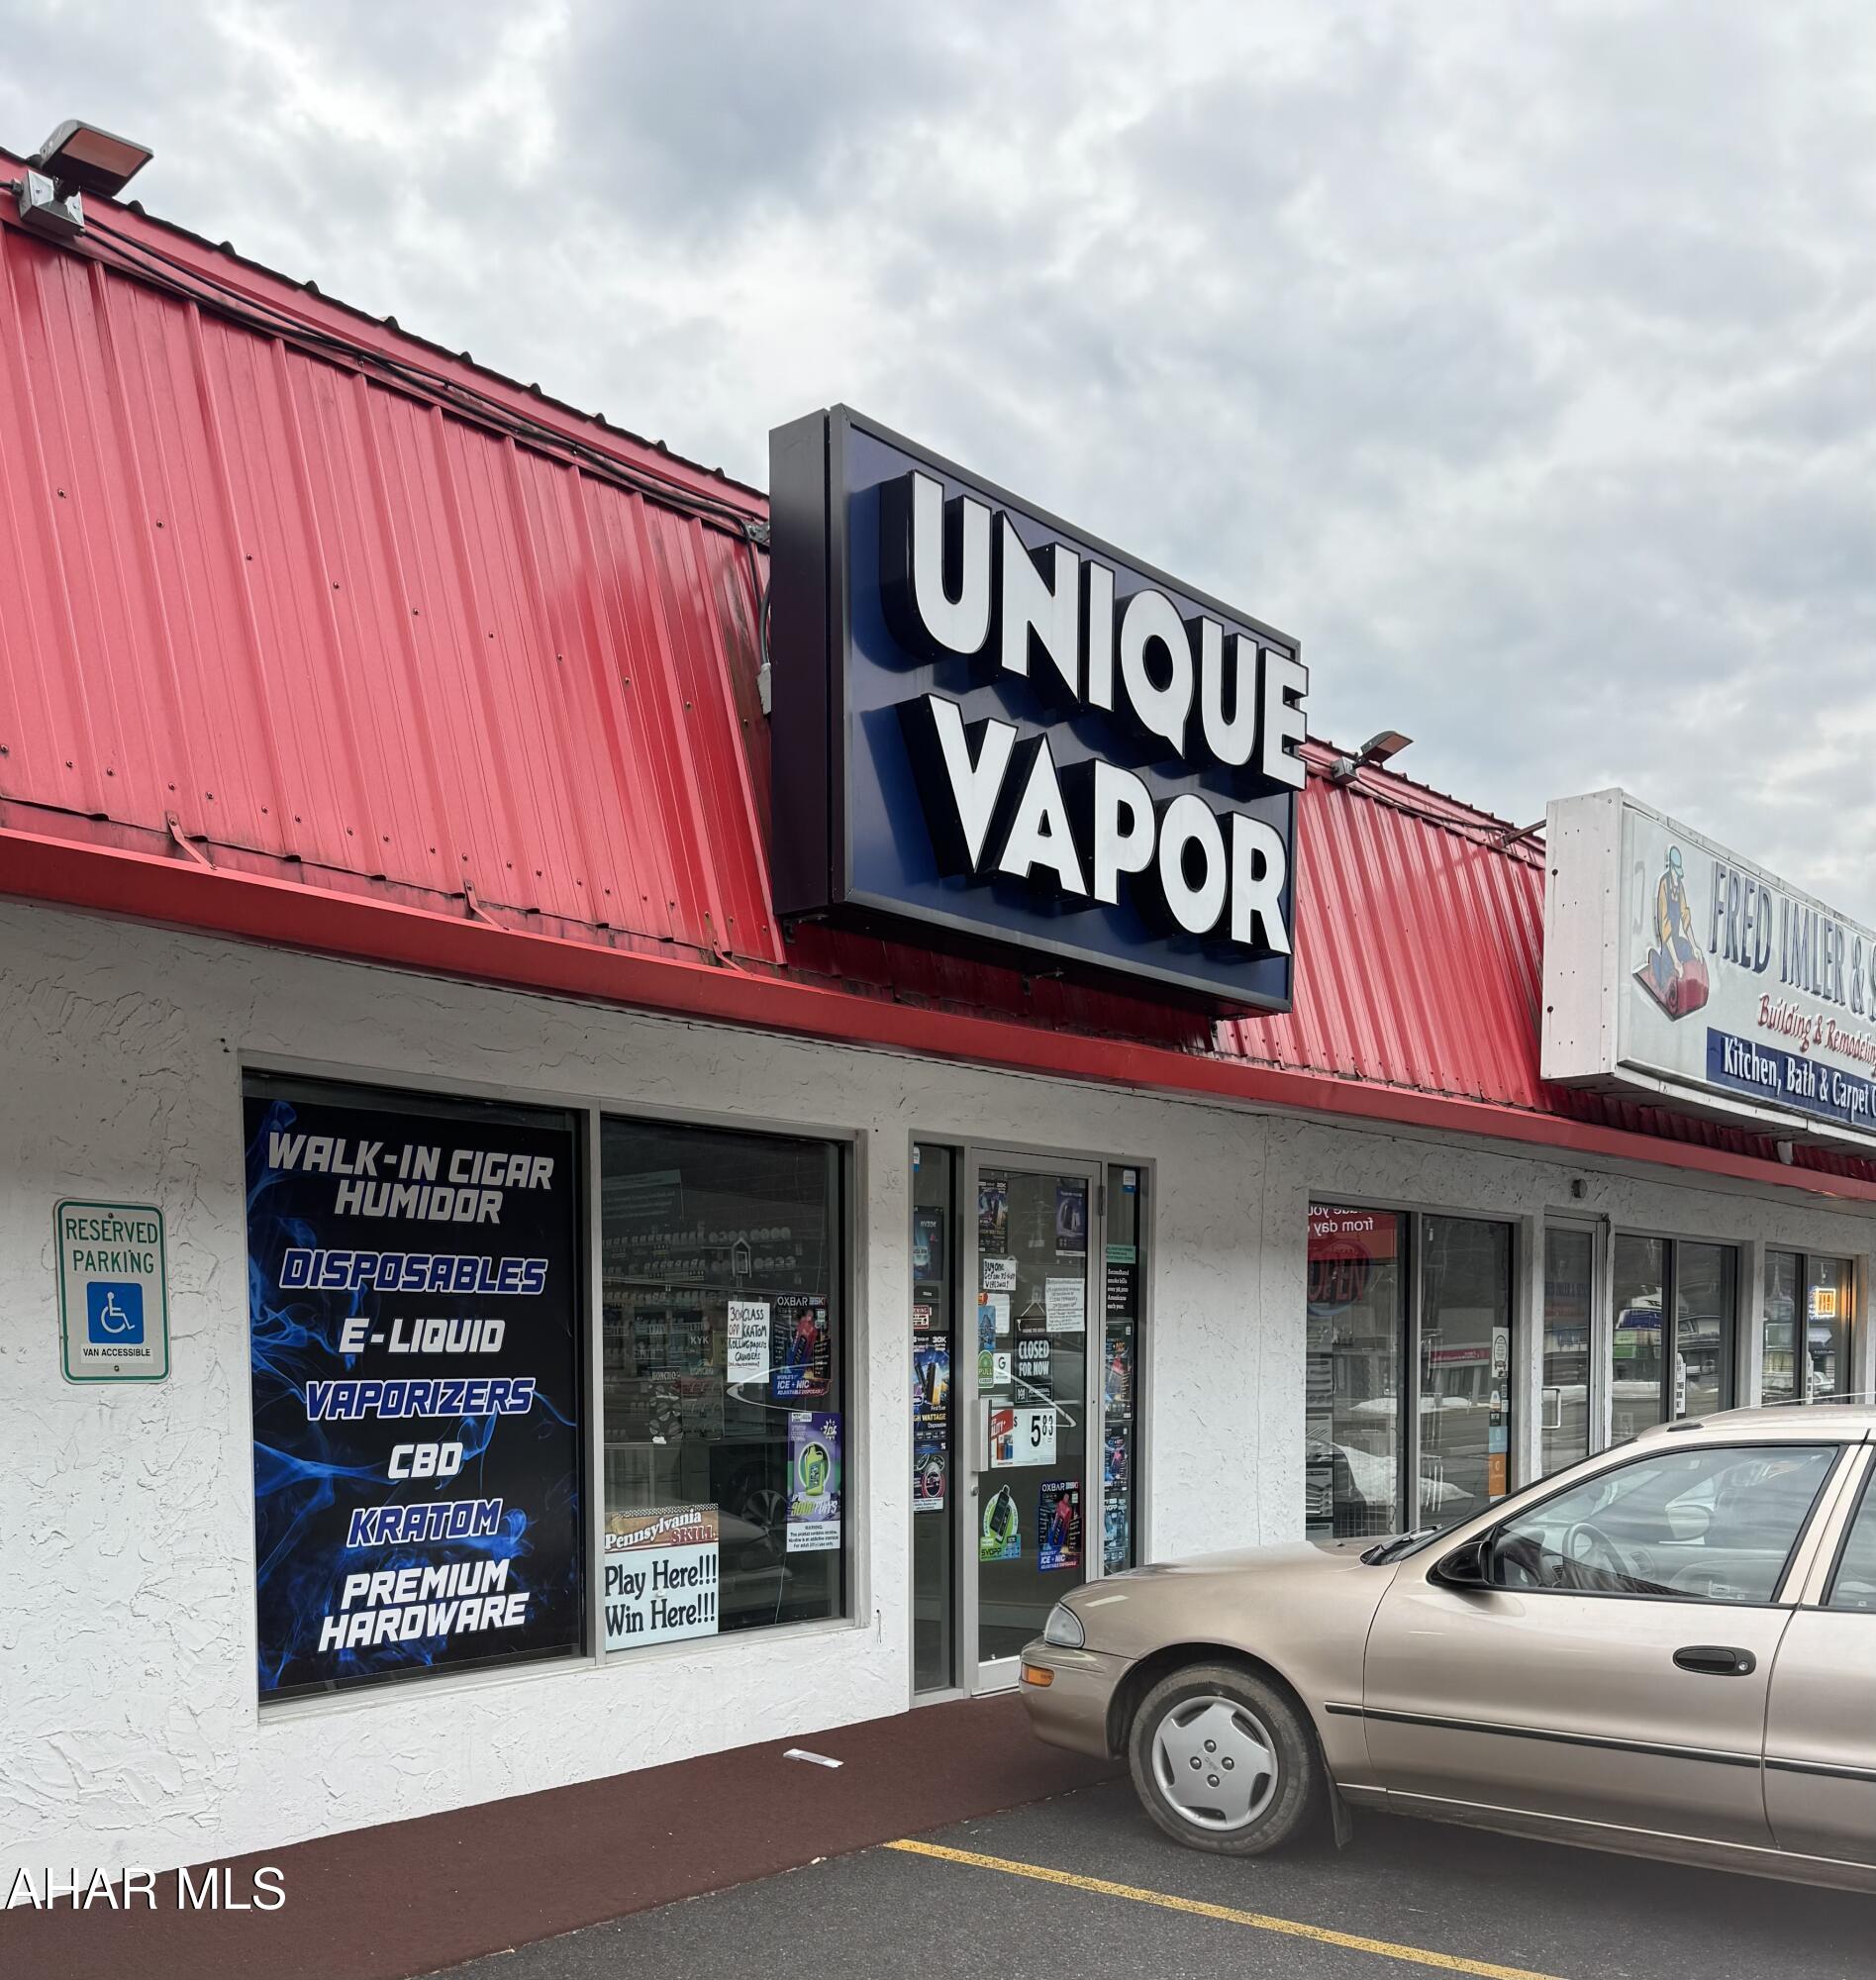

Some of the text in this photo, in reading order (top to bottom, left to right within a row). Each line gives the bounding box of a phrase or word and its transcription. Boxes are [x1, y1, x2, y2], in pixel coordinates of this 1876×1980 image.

[910, 469, 1309, 792] UNIQUE
[928, 693, 1292, 955] VAPOR
[1709, 860, 1772, 973] FRED
[1780, 897, 1845, 1006] IMLER
[1851, 936, 1864, 1015] &
[1757, 993, 1876, 1077] Building & Remodelin
[1725, 1037, 1782, 1097] Kitchen,
[1787, 1056, 1815, 1098] Bath
[1819, 1068, 1828, 1102] &
[1831, 1071, 1869, 1123] Carpet
[268, 1132, 555, 1190] WALK-IN CIGAR
[334, 1180, 504, 1224] HUMIDOR
[65, 1219, 158, 1244] RESERVED
[73, 1249, 153, 1274] PARKING
[279, 1248, 548, 1295] DISPOSABLES
[777, 1297, 808, 1306] OXBAR
[101, 1348, 150, 1357] ACCESSIBLE
[340, 1318, 505, 1353] E-LIQUID
[1019, 1339, 1049, 1359] CLOSED
[777, 1380, 791, 1389] ICE
[796, 1379, 810, 1388] NIC
[1019, 1360, 1049, 1377] FOR NOW
[305, 1377, 536, 1422] VAPORIZERS
[387, 1442, 463, 1479] CBD
[1041, 1482, 1065, 1492] OXBAR
[346, 1498, 503, 1548] KRATOM
[605, 1509, 702, 1549] Pennsylvania
[672, 1525, 713, 1544] SKILL
[340, 1558, 510, 1610] PREMIUM
[605, 1553, 717, 1601] Play Here!!!
[318, 1592, 530, 1652] HARDWARE
[605, 1592, 715, 1637] Win Here!!!
